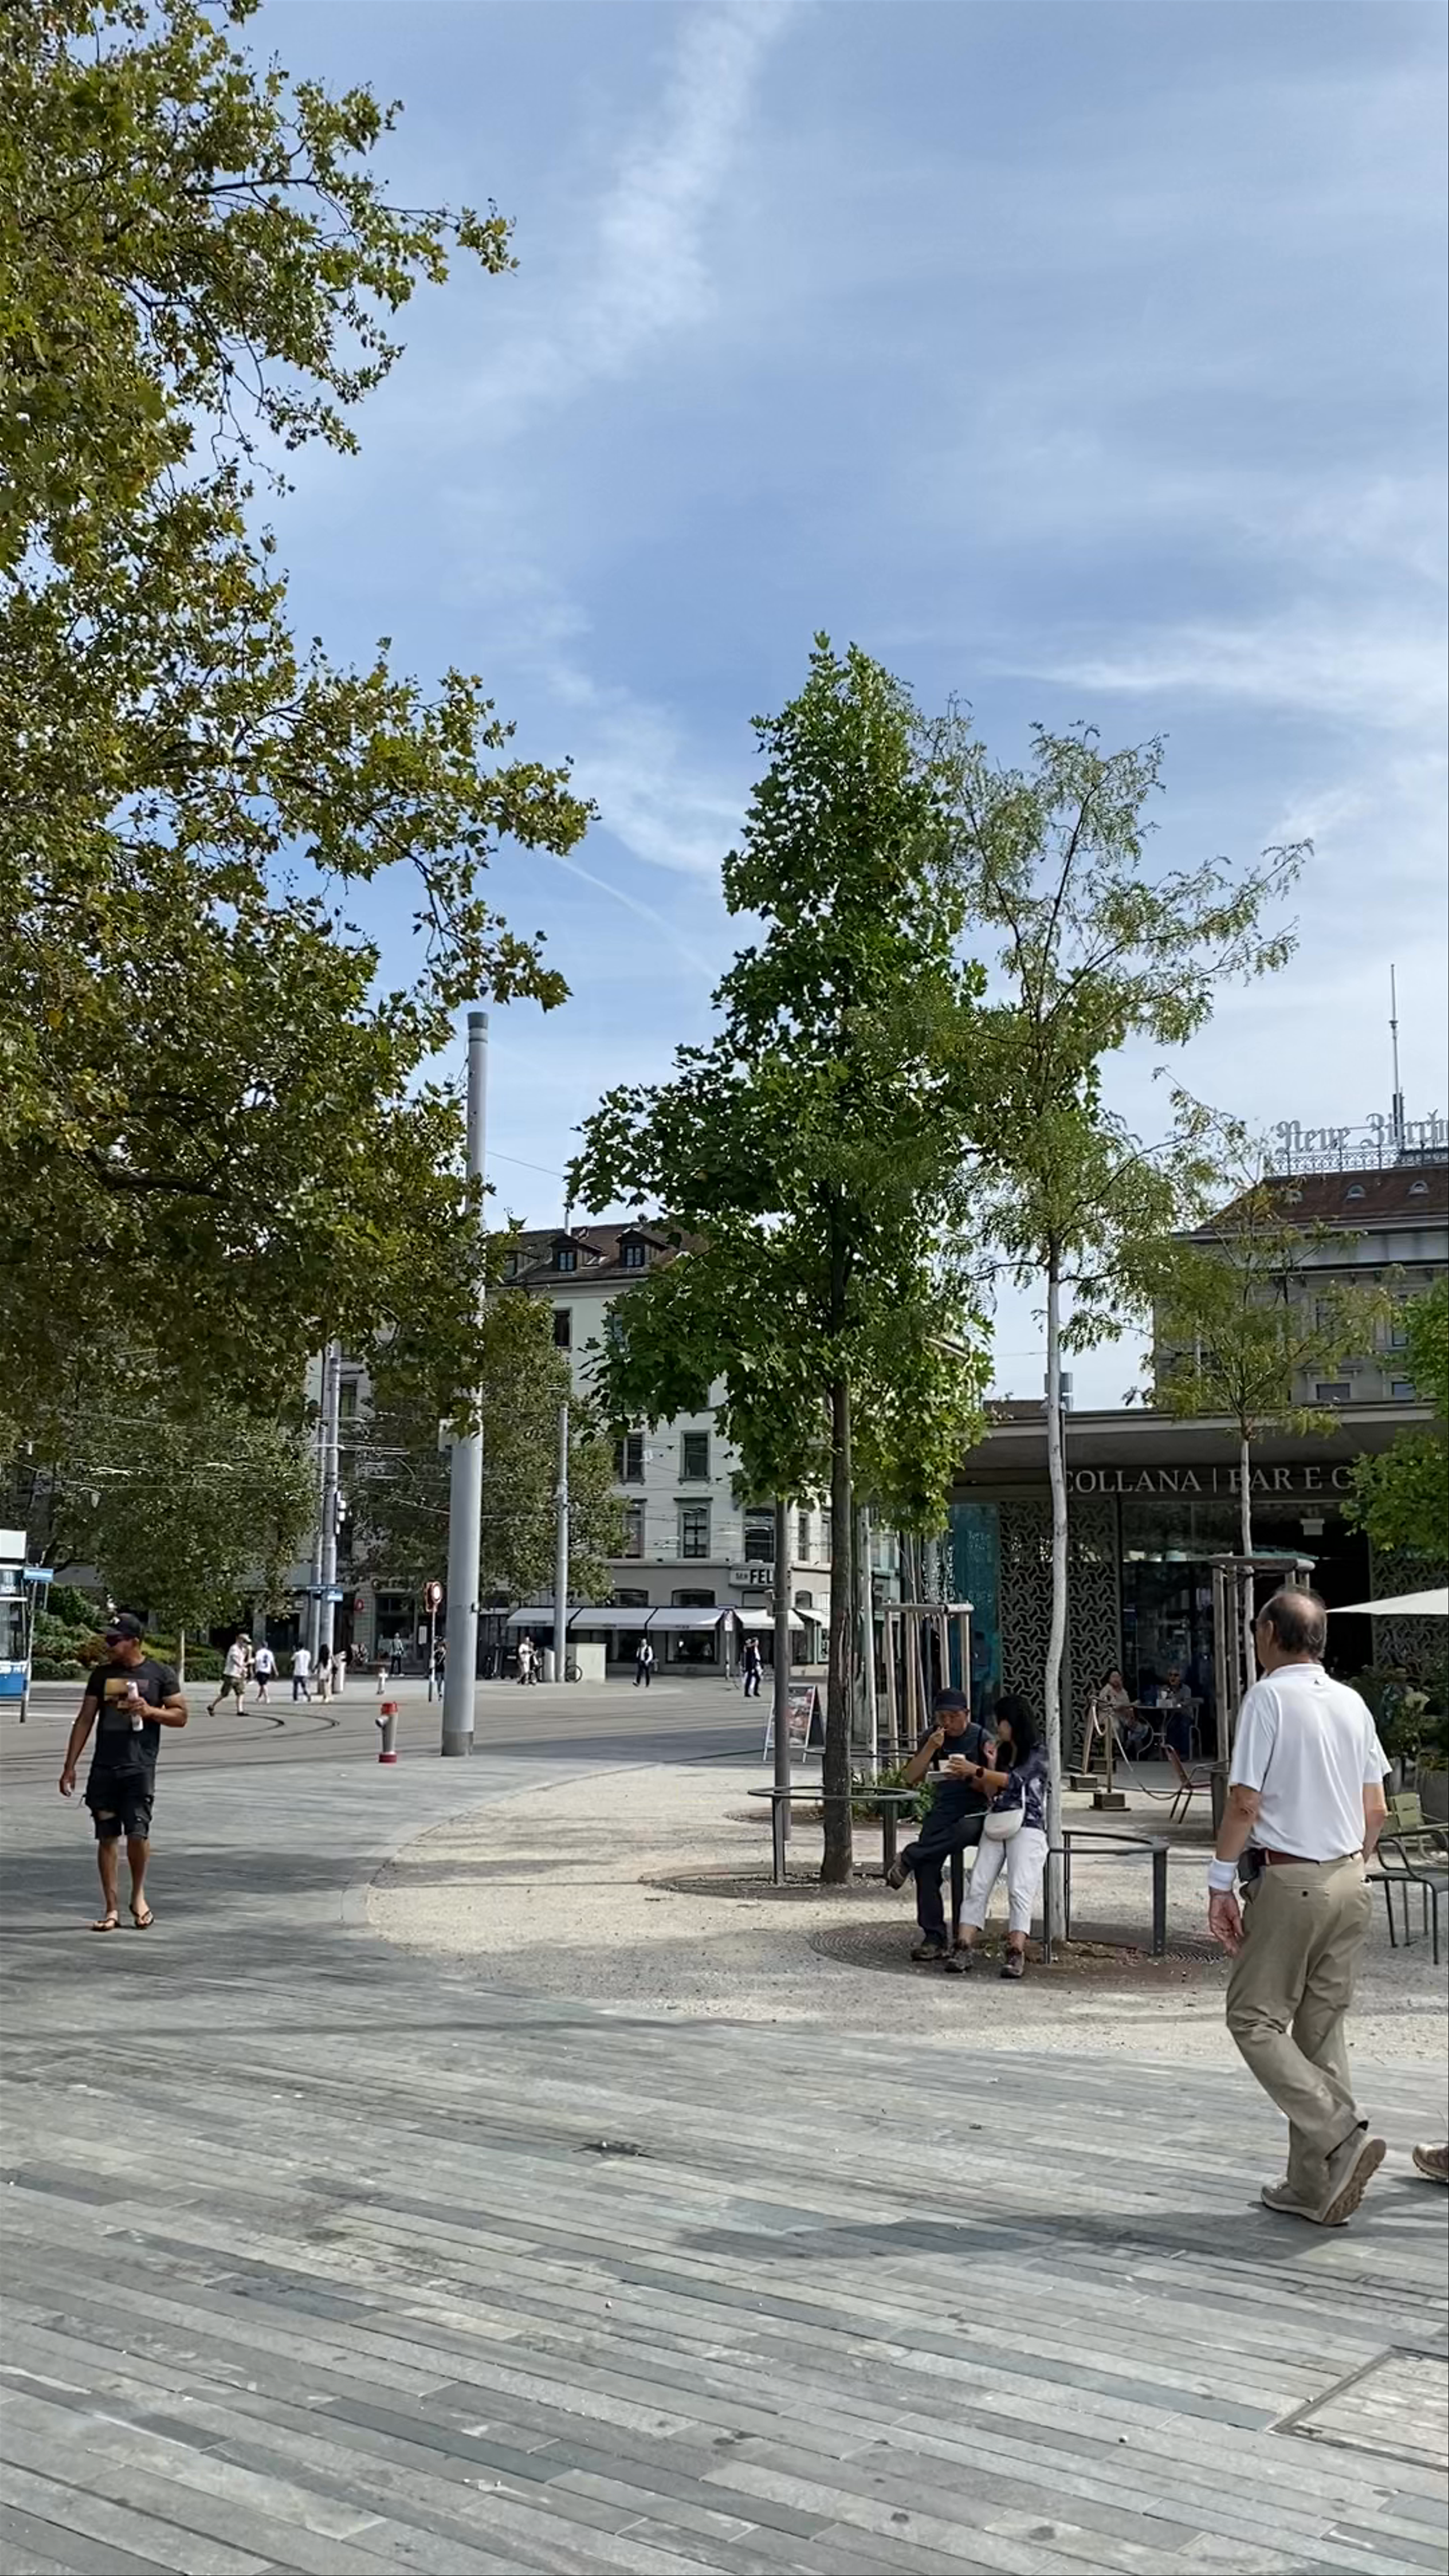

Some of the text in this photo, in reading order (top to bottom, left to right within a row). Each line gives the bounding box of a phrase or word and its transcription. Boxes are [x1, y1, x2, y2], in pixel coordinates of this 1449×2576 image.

[1275, 1120, 1351, 1156] Neue
[1303, 1466, 1322, 1490] E
[750, 1569, 774, 1584] FEL
